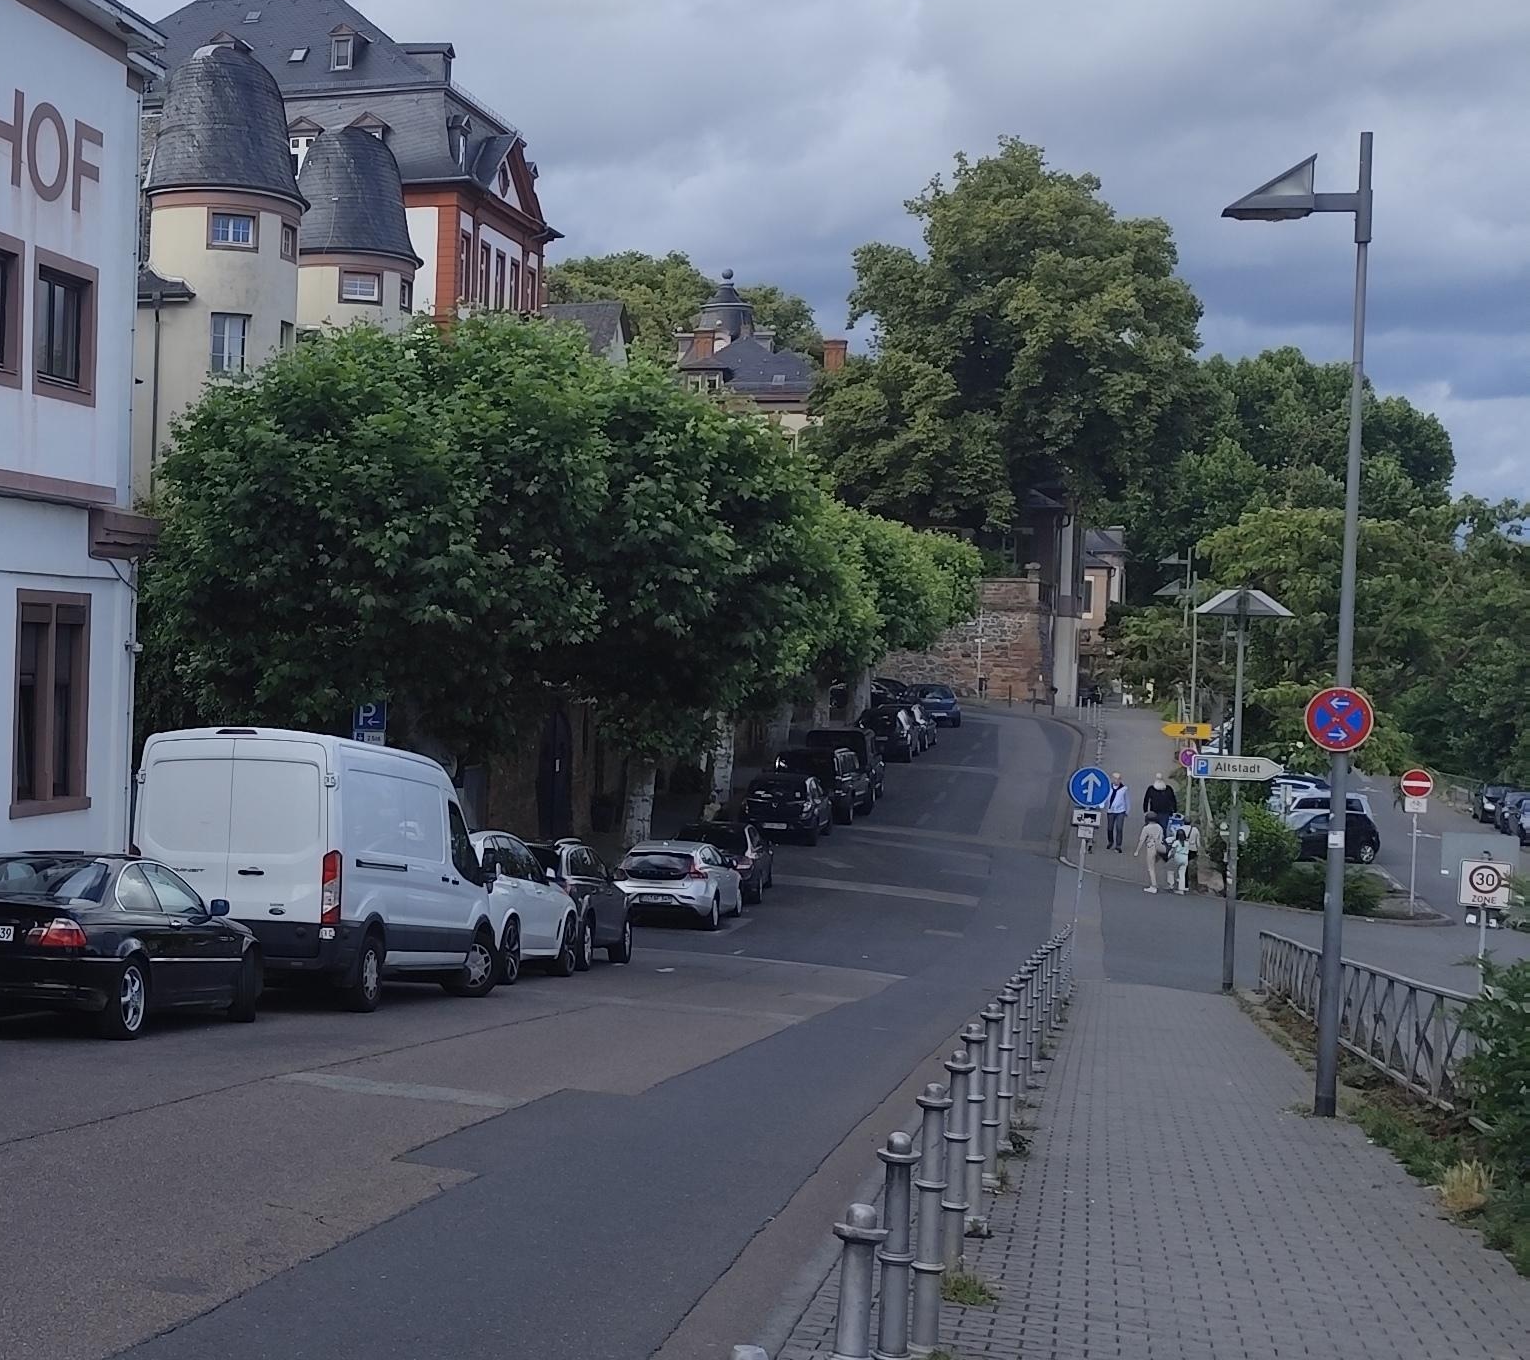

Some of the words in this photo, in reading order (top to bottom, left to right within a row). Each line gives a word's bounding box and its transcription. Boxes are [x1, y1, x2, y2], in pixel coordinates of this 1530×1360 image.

[358, 702, 377, 726] P
[1198, 759, 1208, 771] P
[1214, 761, 1262, 774] Altstadt
[1475, 872, 1495, 887] 30
[1471, 894, 1497, 905] ZONE
